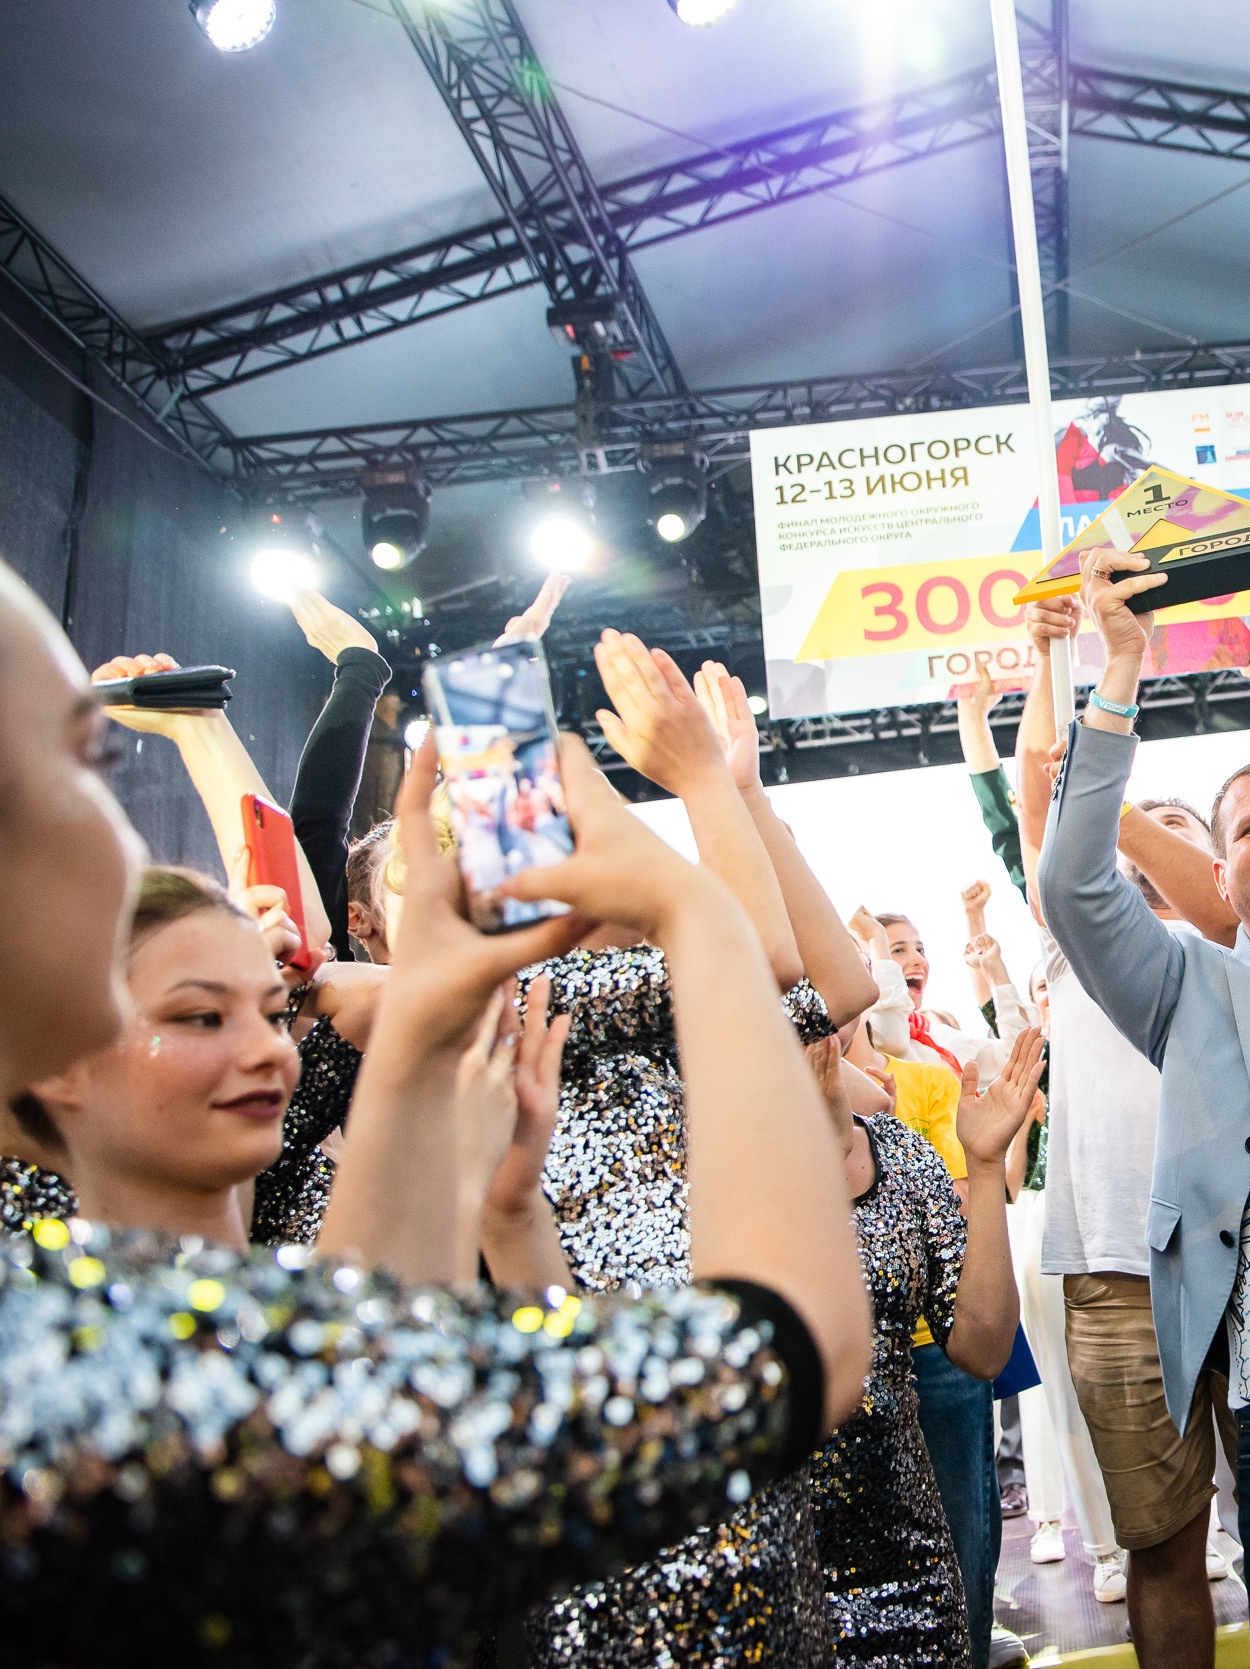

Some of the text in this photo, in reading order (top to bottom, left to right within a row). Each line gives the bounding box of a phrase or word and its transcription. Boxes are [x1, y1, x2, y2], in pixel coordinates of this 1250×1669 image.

[774, 433, 1016, 476] КРАСНОГОРСК
[775, 466, 970, 505] 12-13 ИЮНЯ
[1143, 483, 1171, 505] 1
[777, 502, 980, 530] ФИНАЛ МОЛОДЕЖНОГО ОКРУЖНОГО
[1126, 499, 1189, 518] МЕСТО
[778, 513, 983, 540] КОНКУРСА ИСКУССТВ ЦЕНТРАЛЬНОГО
[779, 531, 912, 551] ФЕДЕРАЛЬНОГО ОКРУГА
